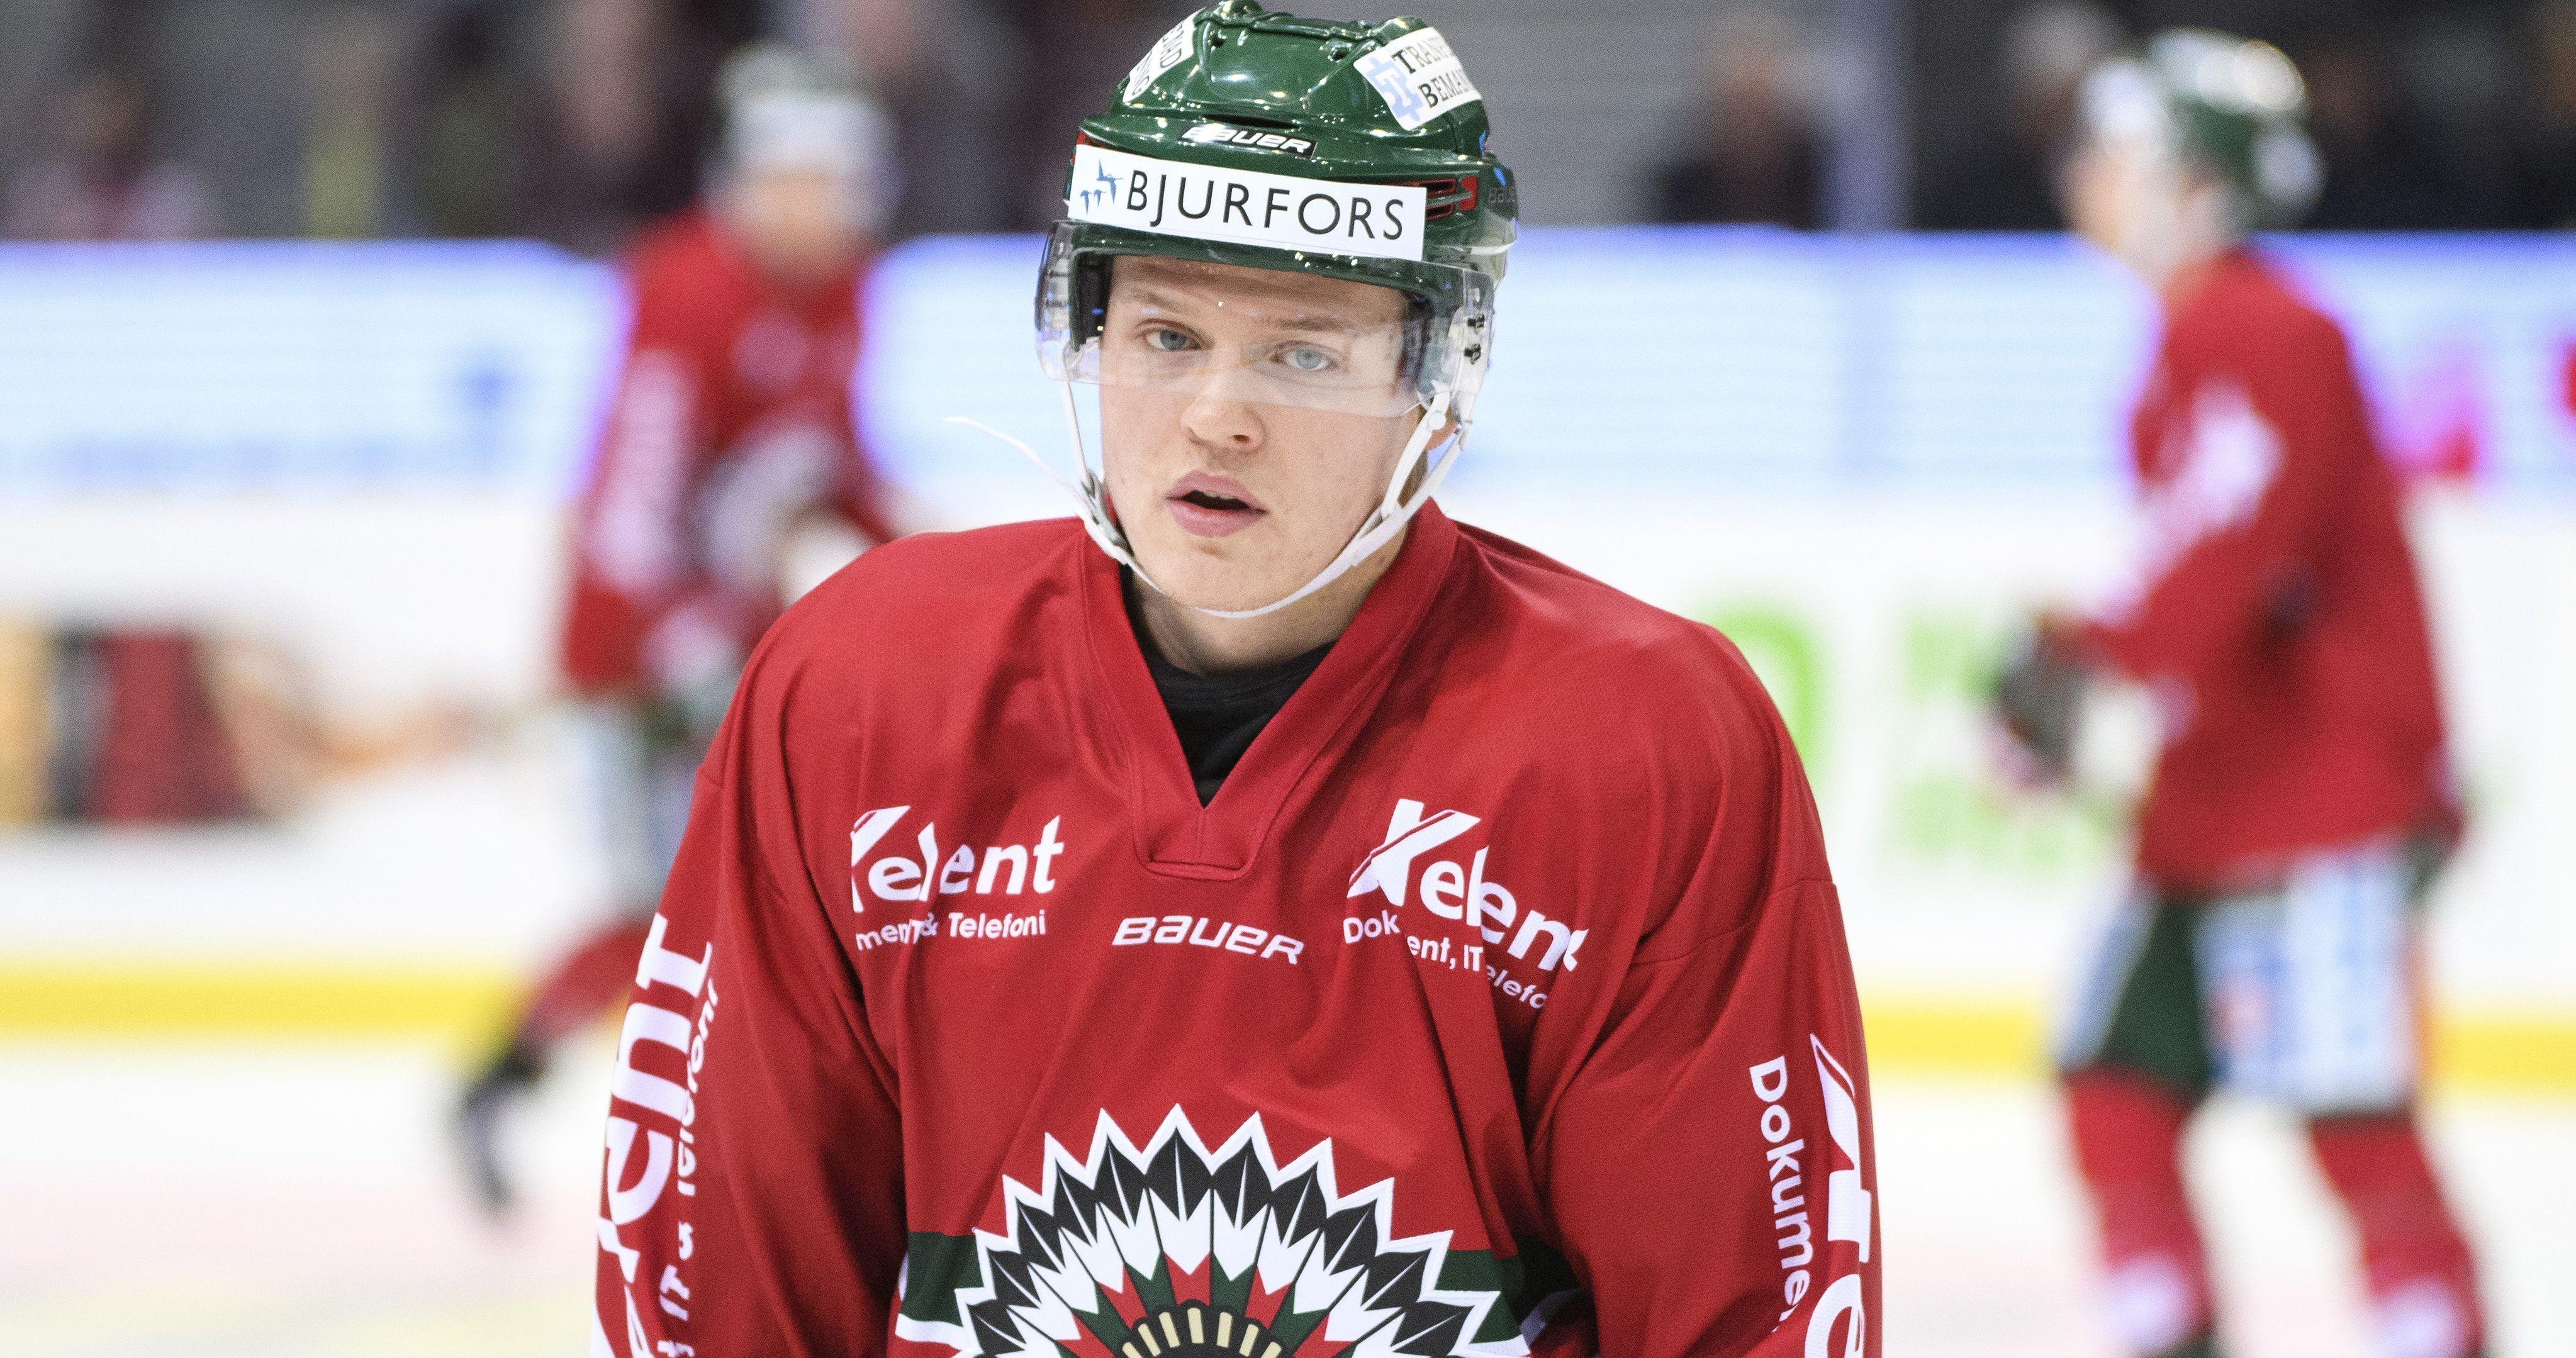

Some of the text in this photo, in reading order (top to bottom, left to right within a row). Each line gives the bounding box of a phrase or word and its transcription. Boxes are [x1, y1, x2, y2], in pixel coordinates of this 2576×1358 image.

[1391, 36, 1450, 74] TRAN
[1126, 169, 1404, 242] BJURFORS
[948, 910, 1046, 938] Telefoni
[1112, 915, 1304, 965] BAUER
